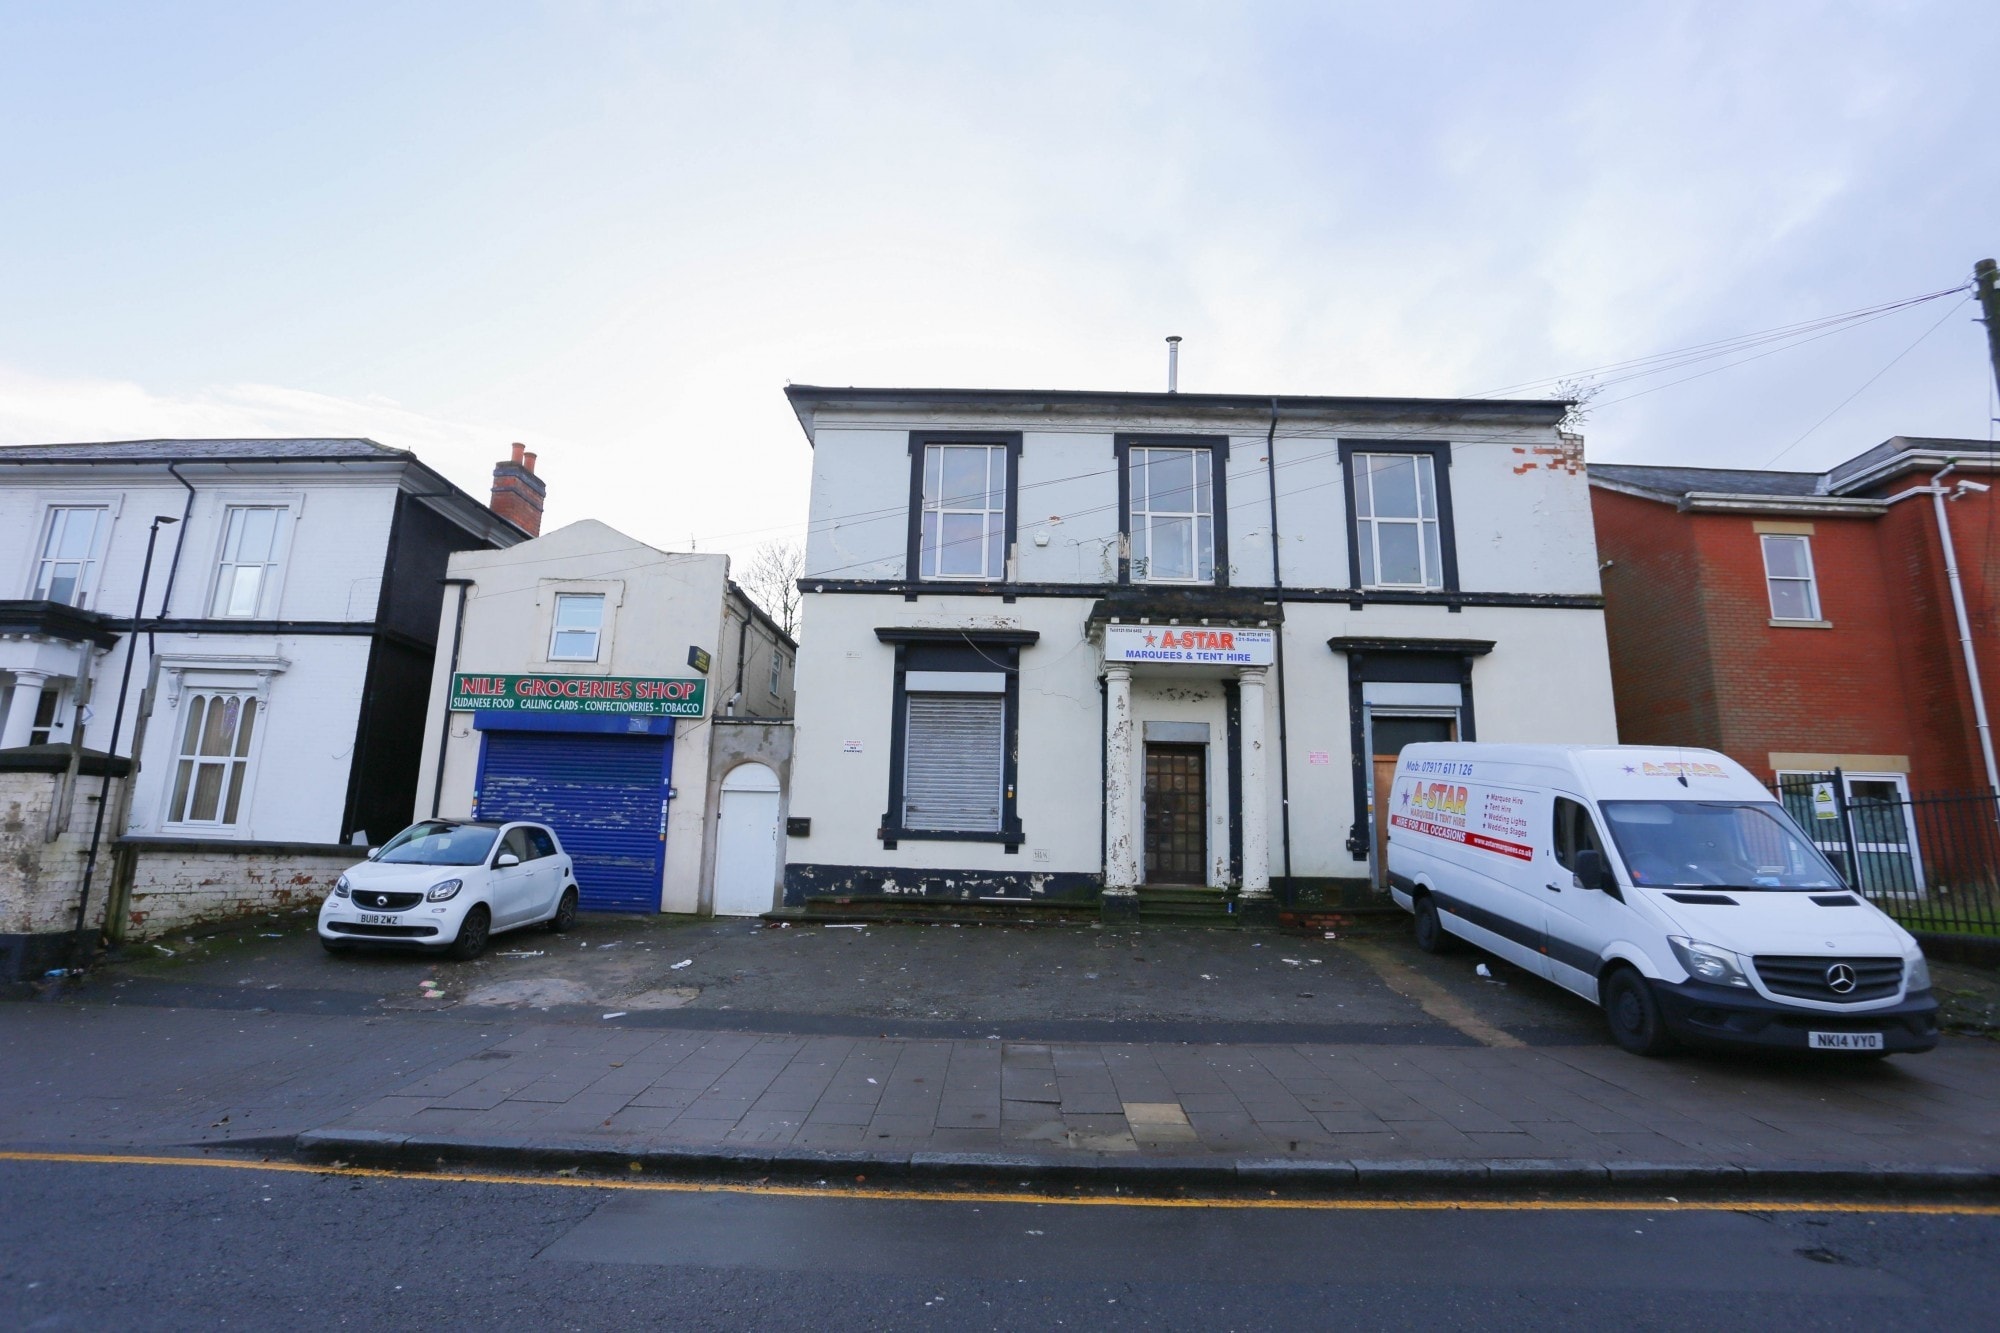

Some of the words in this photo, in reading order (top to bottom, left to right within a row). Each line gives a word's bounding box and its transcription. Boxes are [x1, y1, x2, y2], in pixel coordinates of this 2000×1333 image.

[1160, 630, 1236, 650] A-STAR
[1126, 650, 1183, 660] MARQUEES
[1186, 651, 1193, 660] &
[1196, 652, 1223, 661] TENT
[1226, 653, 1251, 662] HIRE
[461, 677, 506, 695] NILE
[515, 679, 632, 699] GROCERIES
[635, 681, 696, 700] SHOP
[453, 698, 491, 708] SUDANESE
[492, 699, 515, 709] FOOD
[520, 699, 553, 709] CALLING
[553, 700, 579, 711] CARDS
[584, 701, 654, 712] CONFECTIONERIES
[661, 702, 700, 713] TOBACCO
[1406, 760, 1420, 772] Mob:
[1421, 761, 1442, 774] 07917
[1443, 763, 1456, 775] 611
[1459, 763, 1473, 776] 126
[1411, 781, 1468, 815] A-STAR
[1490, 793, 1511, 804] Marquee
[1512, 797, 1524, 805] Hire
[1489, 803, 1500, 812] Tent
[1500, 804, 1512, 813] Hire
[1410, 808, 1434, 821] MARQUEES
[1439, 813, 1452, 824] TENT
[1453, 816, 1466, 827] HIRE
[1488, 813, 1510, 825] Wedding
[1511, 816, 1527, 827] Lights
[1395, 816, 1408, 828] HIRE
[1408, 819, 1420, 831] FOR
[1419, 821, 1430, 834] ALL
[1430, 825, 1467, 842] OCCASIONS
[1487, 822, 1509, 835] Wedding
[1509, 826, 1527, 838] Stages
[361, 914, 379, 923] BU18
[381, 915, 398, 925] ZWZ
[1817, 1034, 1848, 1047] NK14
[1851, 1035, 1876, 1048] VYO
